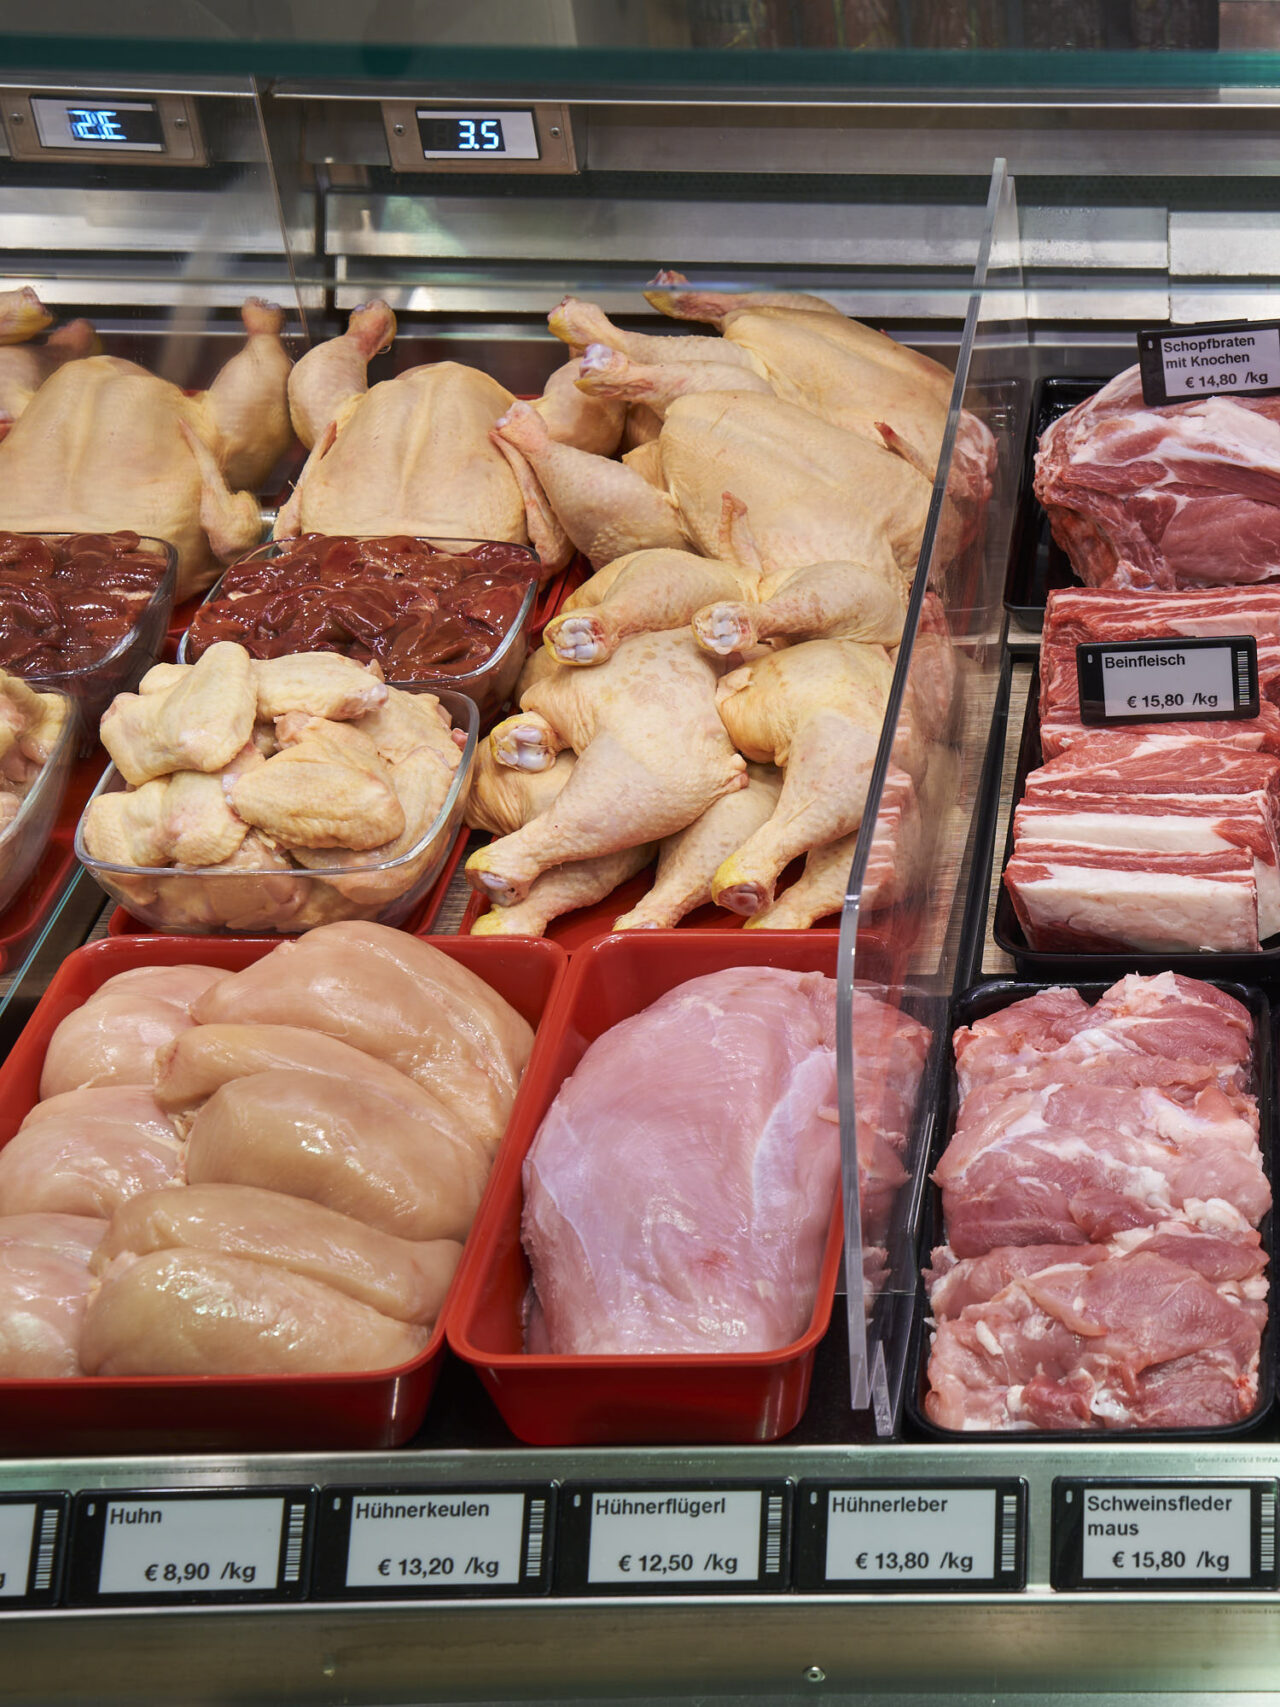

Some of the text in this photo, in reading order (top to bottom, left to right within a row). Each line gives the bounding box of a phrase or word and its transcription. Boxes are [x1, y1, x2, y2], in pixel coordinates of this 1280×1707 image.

[458, 120, 500, 150] 3.5
[1164, 337, 1255, 353] Schopfbraten
[1166, 353, 1250, 369] mit Knochen
[1185, 371, 1268, 389] € 14,80 /kg
[1105, 653, 1185, 669] Beinfleisch
[1127, 692, 1218, 709] € 15,80 /kg
[356, 1501, 489, 1519] Hühnerkeulen
[596, 1497, 725, 1518] Hühnerflügerl
[832, 1496, 948, 1513] Hühnerleber
[1088, 1495, 1232, 1511] Schweinsfleder
[110, 1508, 162, 1525] Huhn
[1088, 1523, 1139, 1536] maus
[378, 1557, 499, 1578] € 13,20 /kg
[618, 1553, 738, 1574] € 12,50 /kg
[855, 1552, 973, 1573] € 13,80 /kg
[1112, 1551, 1229, 1572] € 15,80 /kg
[144, 1562, 256, 1584] € 8,90 /kg
